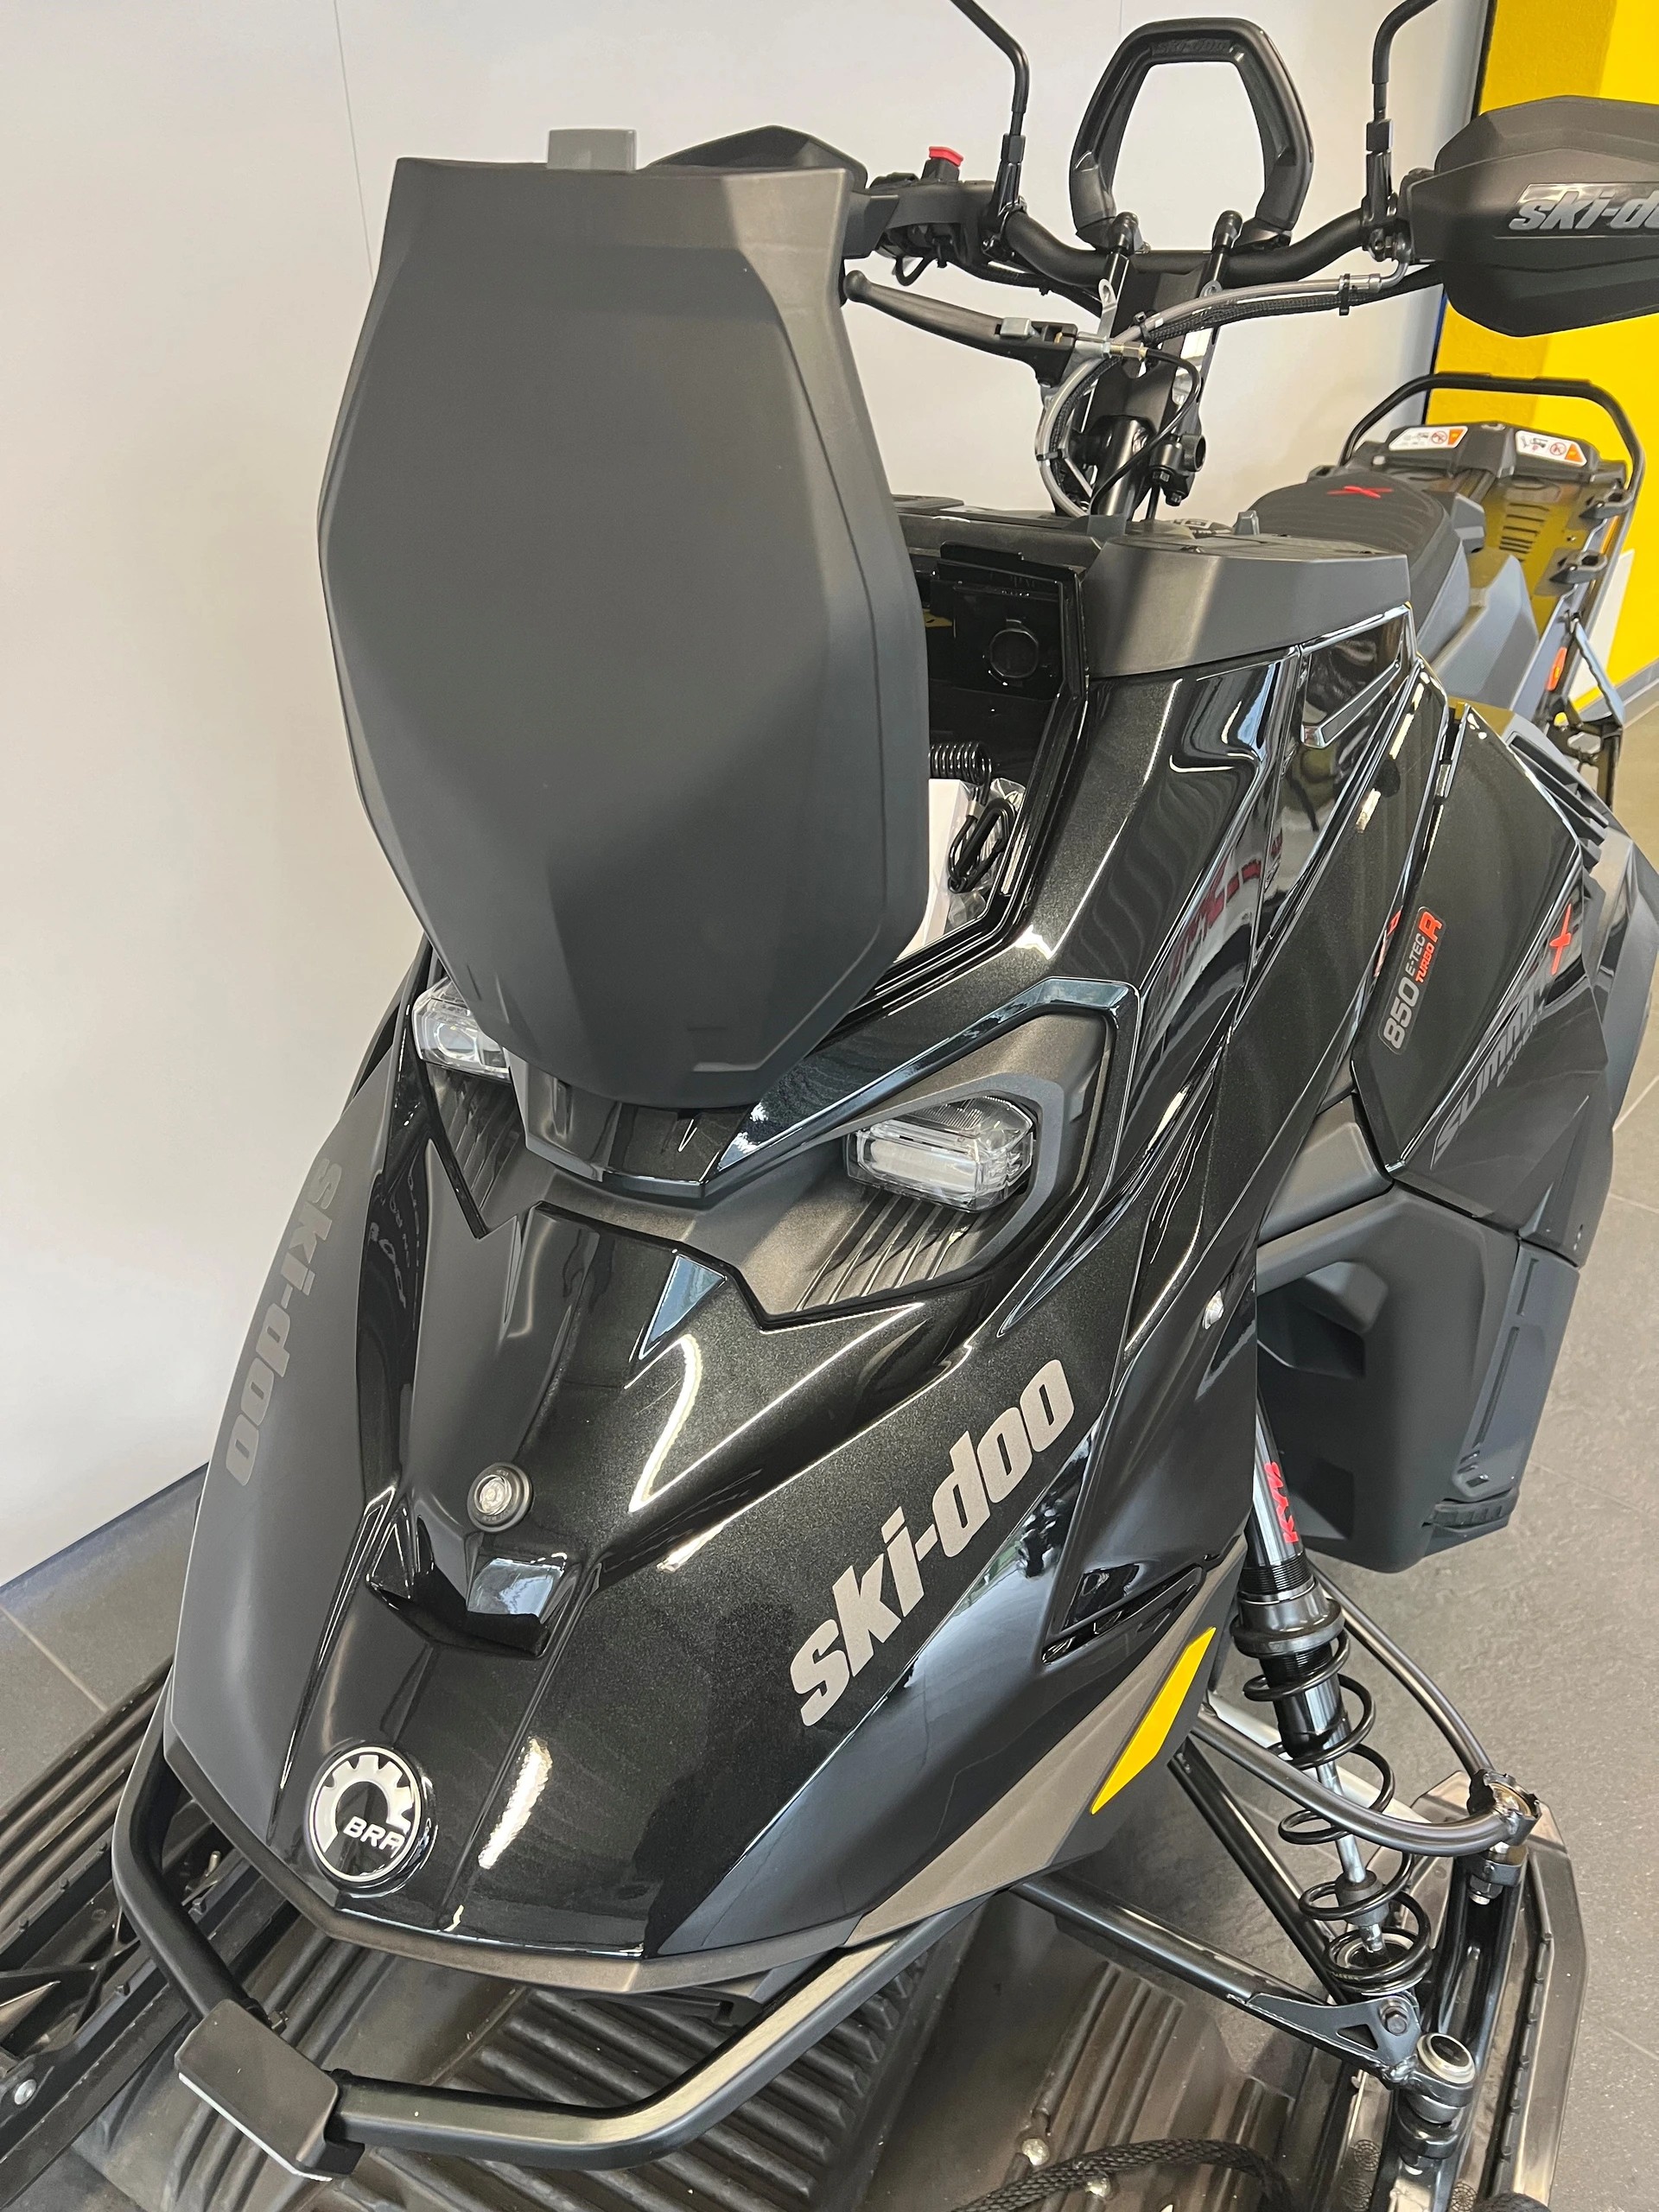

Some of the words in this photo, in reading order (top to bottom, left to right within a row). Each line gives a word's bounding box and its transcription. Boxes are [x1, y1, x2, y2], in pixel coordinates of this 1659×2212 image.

[1415, 942, 1435, 983] TURBO
[1419, 911, 1443, 944] R
[1383, 976, 1420, 1049] 850
[1405, 933, 1426, 977] E-TEC
[790, 1359, 1075, 1727] ski-doo
